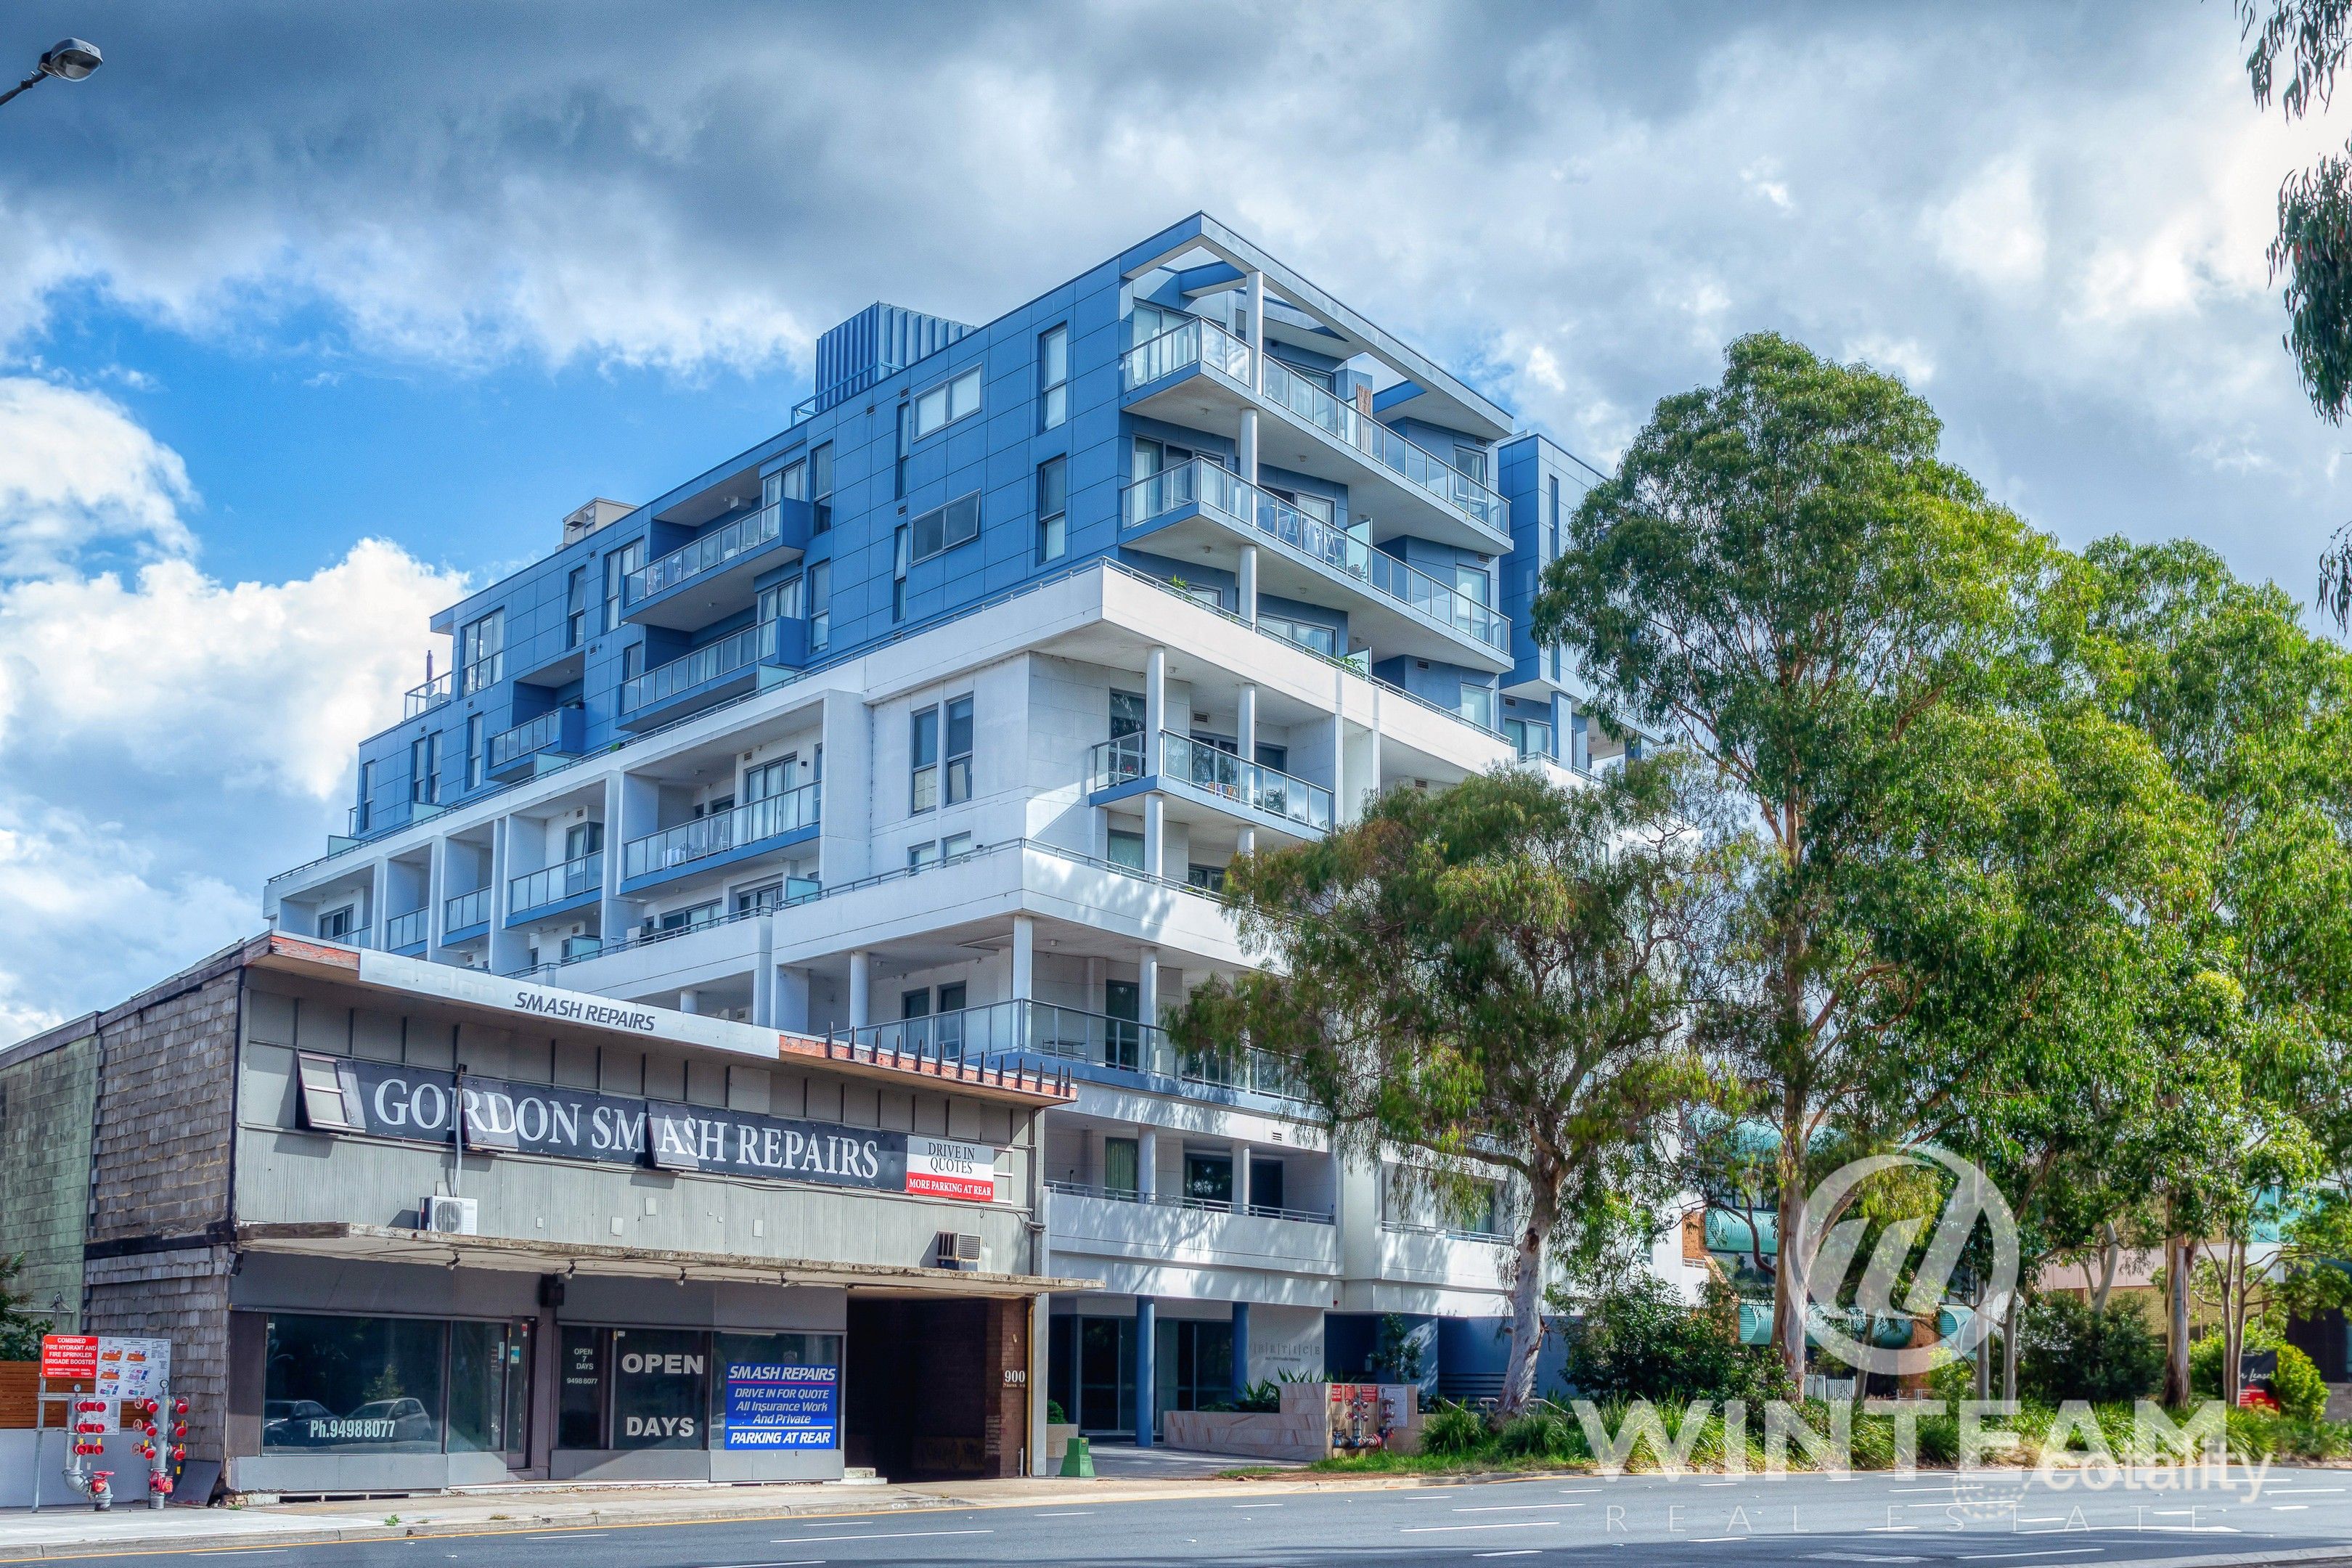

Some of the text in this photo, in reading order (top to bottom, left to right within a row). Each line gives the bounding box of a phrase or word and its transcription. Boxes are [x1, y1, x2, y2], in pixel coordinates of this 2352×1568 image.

[515, 992, 581, 1018] SMASH
[585, 1005, 656, 1032] REPAIRS
[374, 1078, 879, 1179] GORDON SMASH REPAIRS
[928, 1142, 976, 1160] DRIVE IN
[930, 1157, 973, 1174] QUOTES
[909, 1178, 992, 1196] MORE PARKING AT REAR
[622, 1353, 704, 1374] OPEN
[728, 1365, 836, 1381] SMASH REPAIRS
[1004, 1370, 1026, 1382] 900
[735, 1388, 829, 1399] DRIVE IN FOR QUOTE
[735, 1401, 828, 1412] All Insurance Work
[626, 1417, 695, 1437] DAYS
[752, 1413, 812, 1424] And Private
[730, 1432, 830, 1444] PARKING AT REAR
